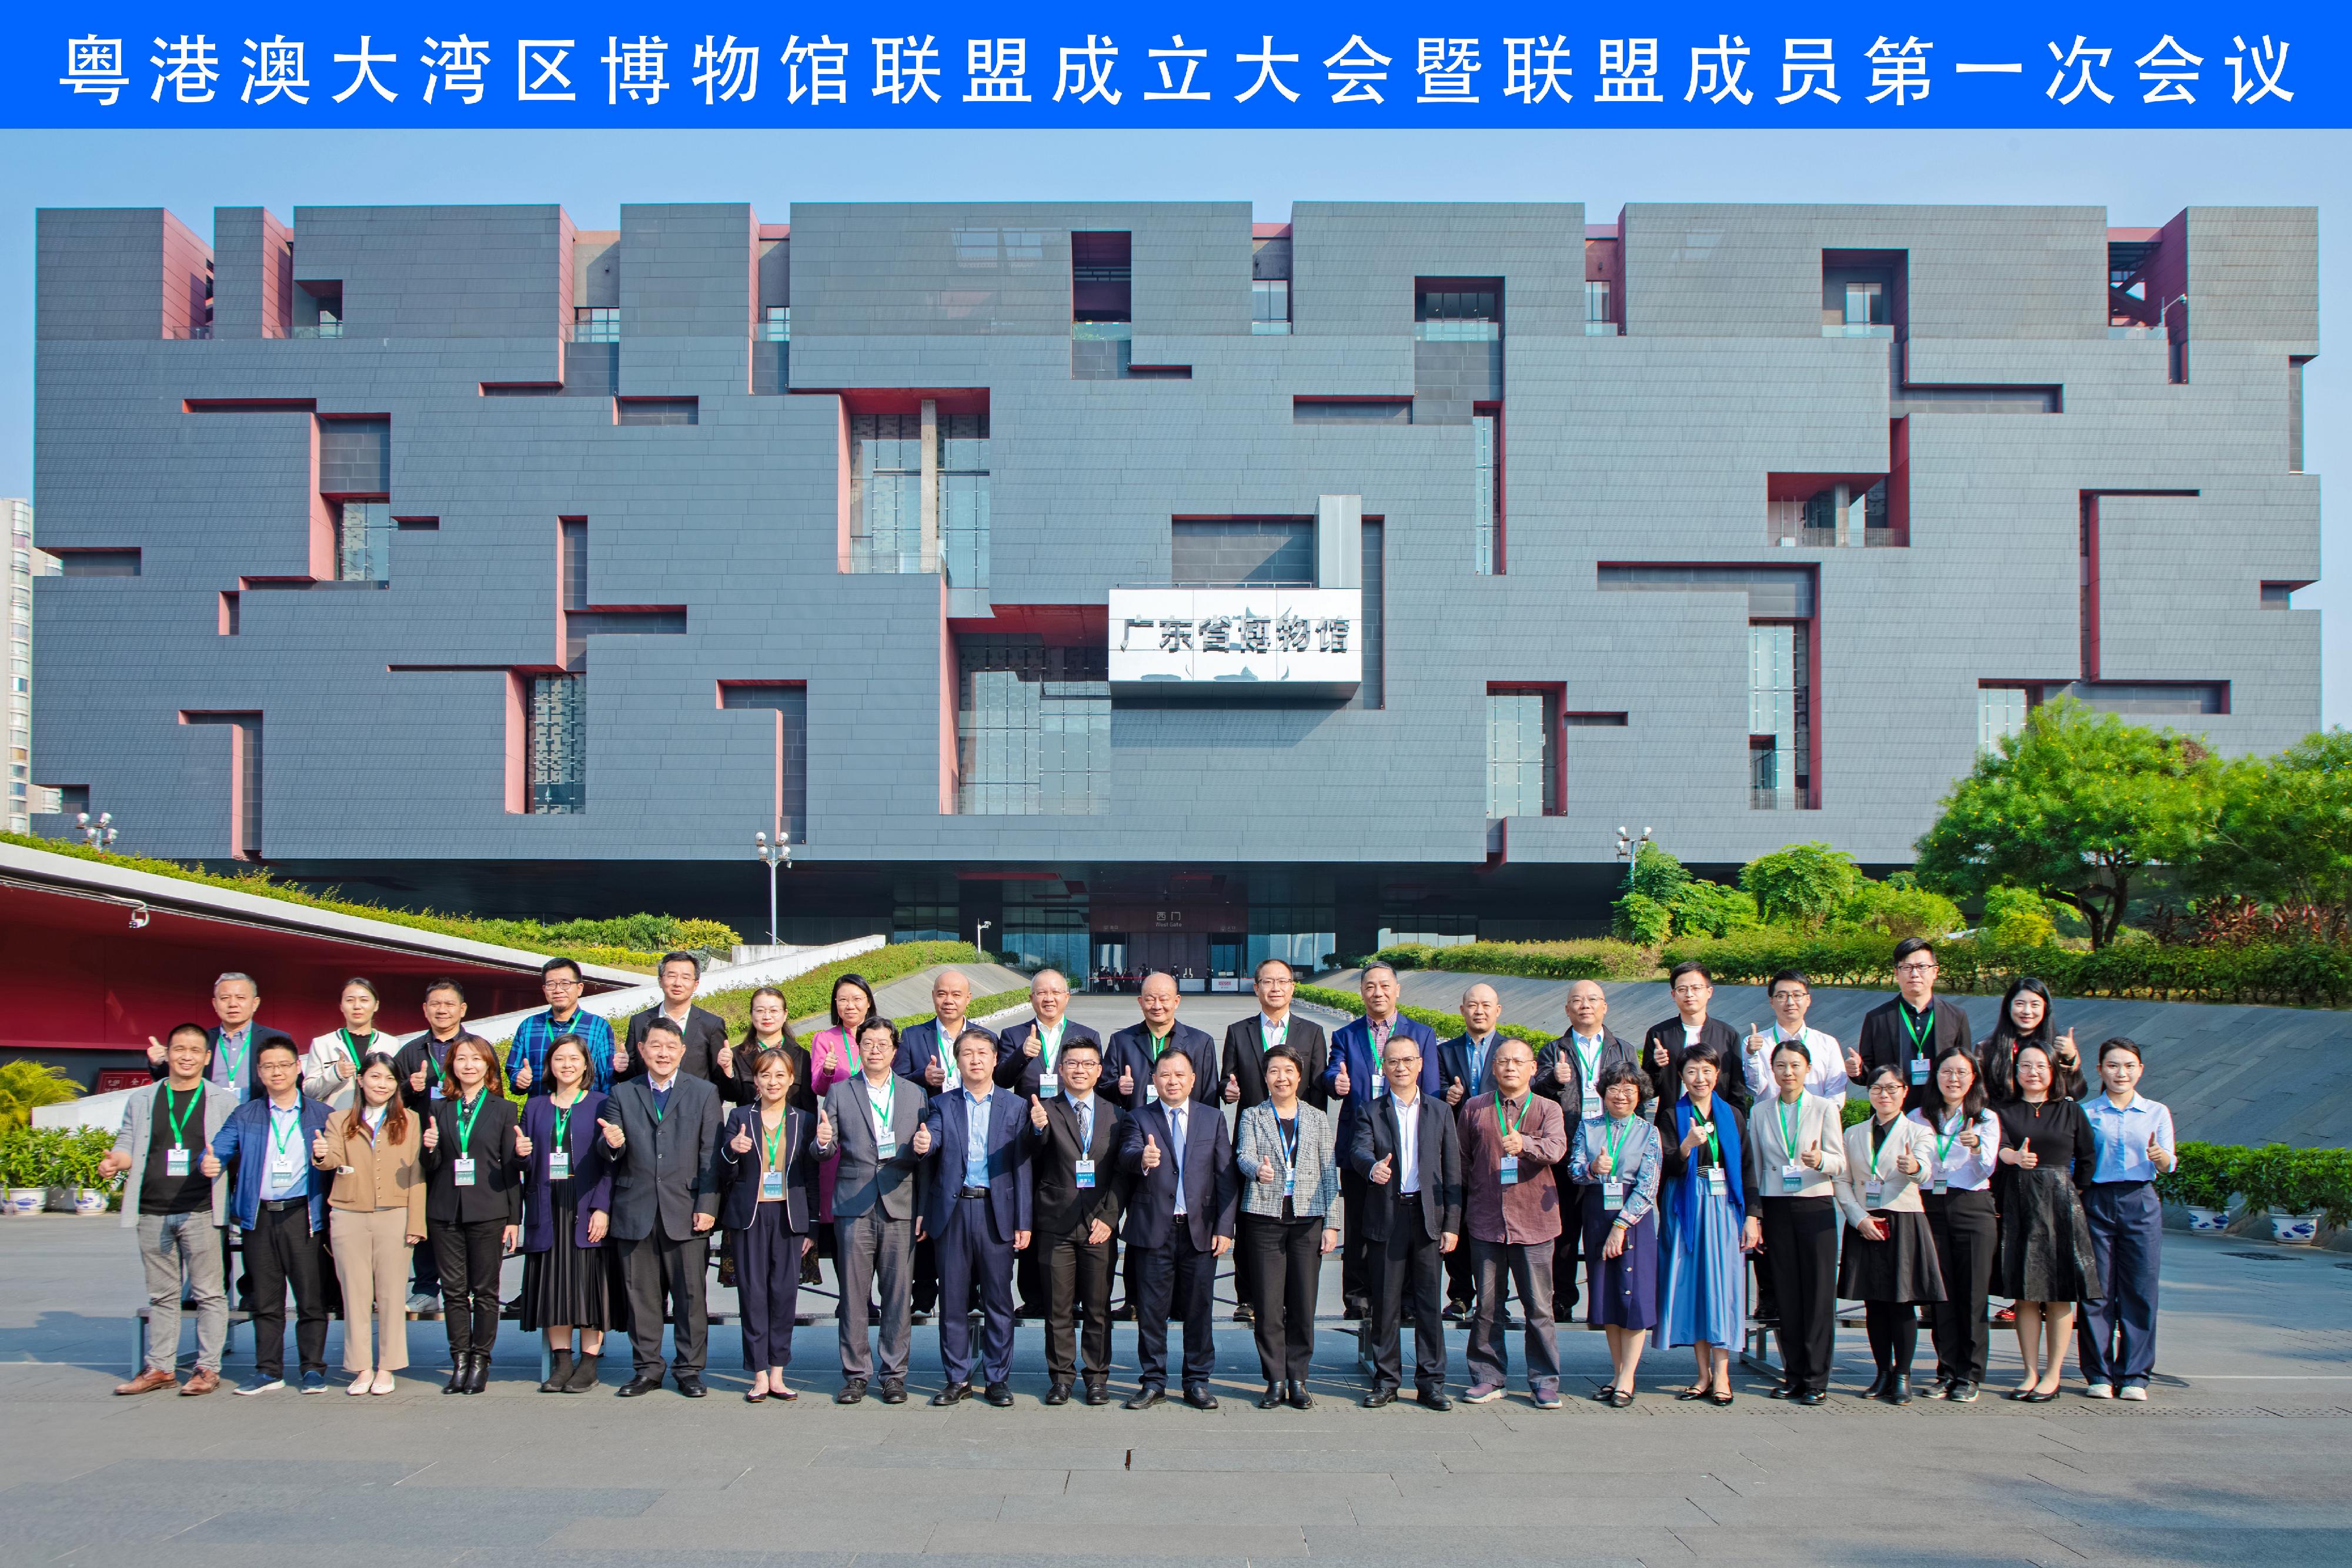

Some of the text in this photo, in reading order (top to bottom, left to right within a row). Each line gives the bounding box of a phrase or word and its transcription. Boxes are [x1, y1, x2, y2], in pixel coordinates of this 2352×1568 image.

[1120, 614, 1350, 653] 广东省博物馆
[1157, 911, 1181, 921] 西门
